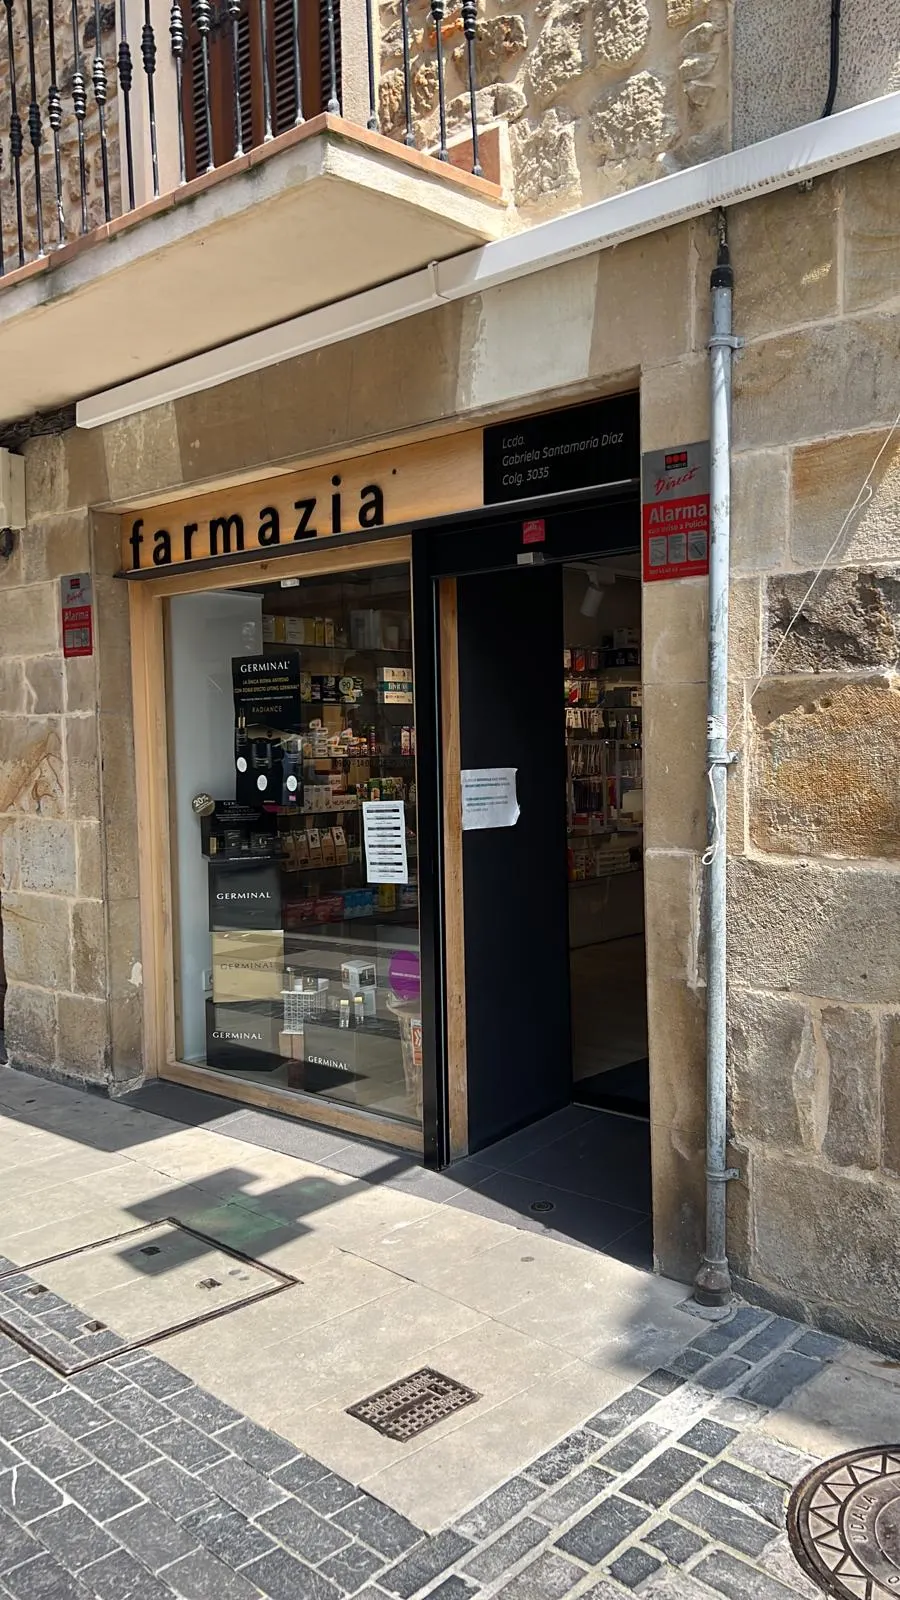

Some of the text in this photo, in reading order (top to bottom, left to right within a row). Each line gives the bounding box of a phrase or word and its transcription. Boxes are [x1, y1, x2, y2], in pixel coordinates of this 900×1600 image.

[502, 449, 541, 466] Gabriela
[601, 432, 624, 446] Díaz
[502, 466, 550, 486] Colg. 3035
[129, 475, 385, 570] farmazia
[649, 503, 708, 524] Alarma
[216, 891, 271, 900] GERMINAL
[220, 962, 274, 970] GERMINAL
[212, 1031, 262, 1040] GERMINAL
[308, 1055, 348, 1071] GERMINAL
[850, 1495, 878, 1542] UDALA
